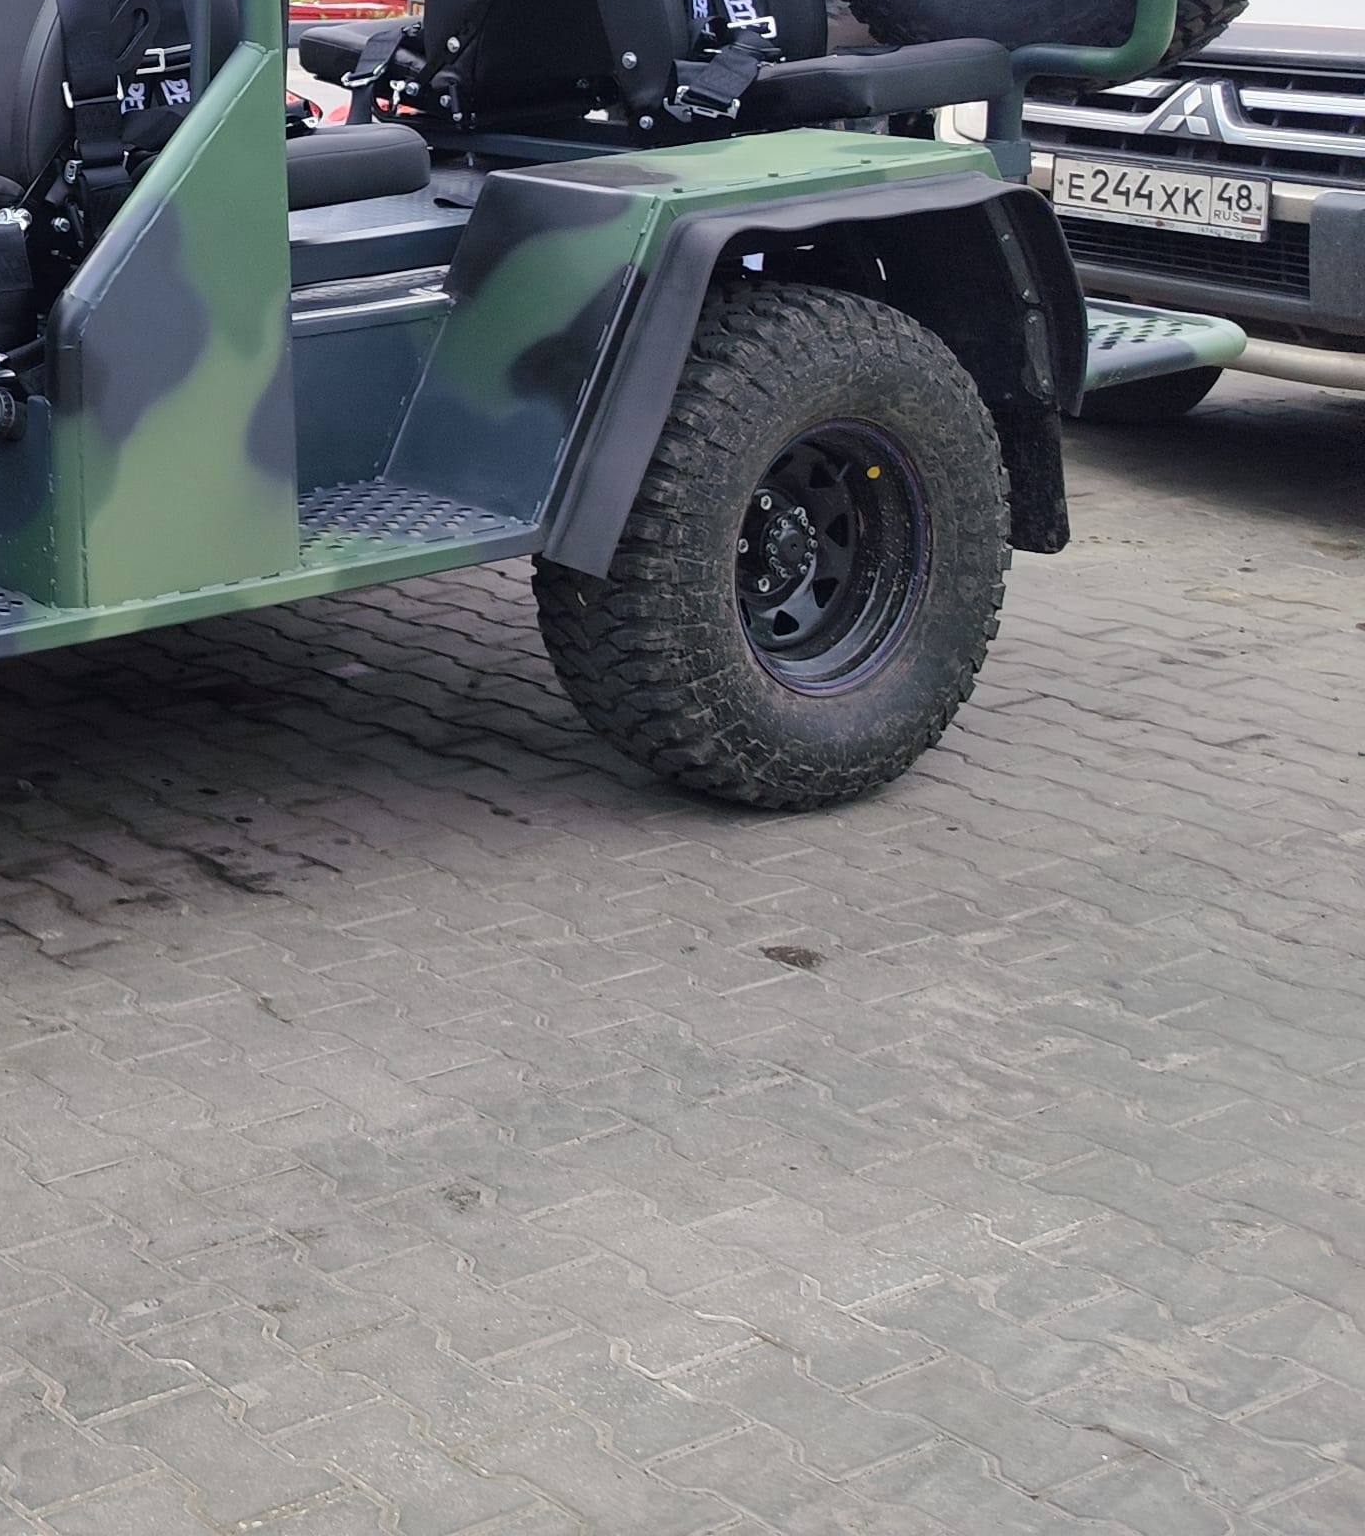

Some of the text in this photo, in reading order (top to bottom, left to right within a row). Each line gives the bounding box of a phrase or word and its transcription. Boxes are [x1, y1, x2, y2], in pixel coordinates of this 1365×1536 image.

[1068, 168, 1253, 218] Е244ХК 48
[1213, 209, 1241, 223] RUS
